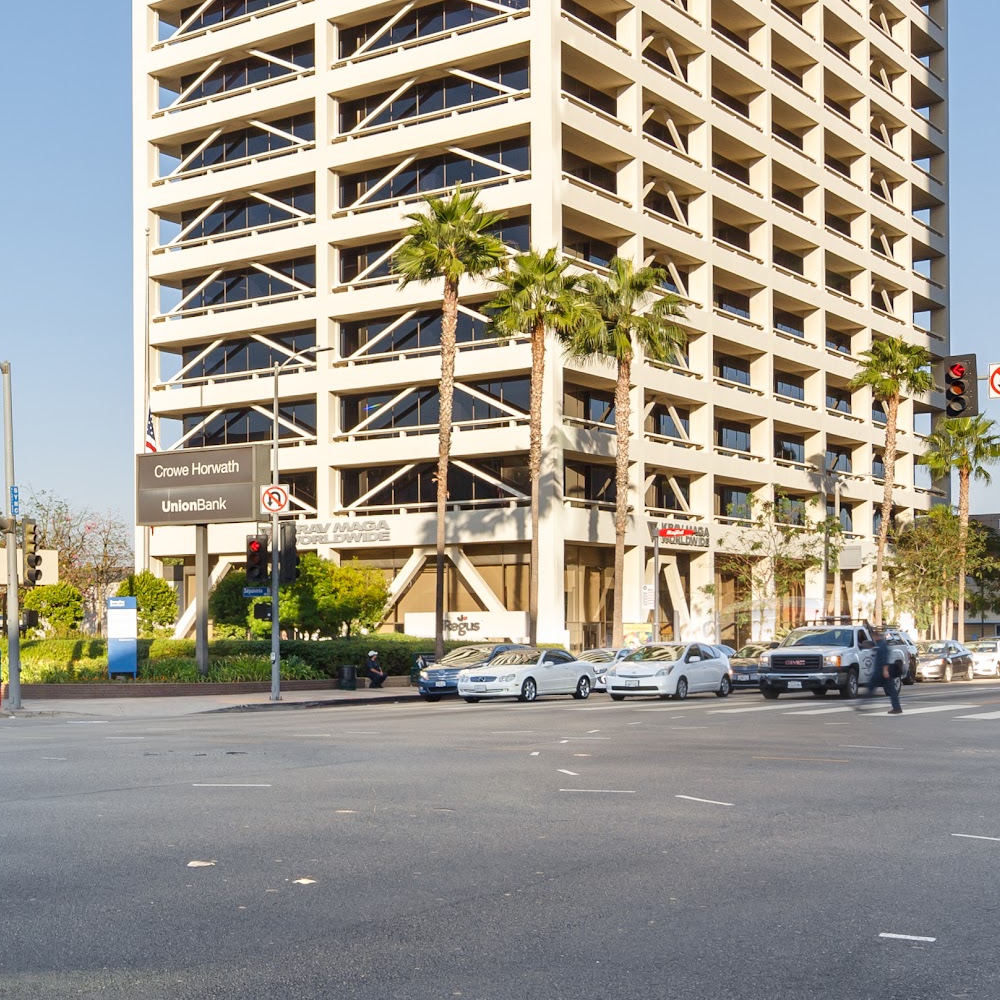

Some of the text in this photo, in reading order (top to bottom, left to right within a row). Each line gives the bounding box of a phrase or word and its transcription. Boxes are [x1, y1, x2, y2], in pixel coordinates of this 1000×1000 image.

[154, 459, 240, 478] Crowe Horwath
[161, 497, 227, 512] UnionBank
[296, 520, 390, 535] RAV MAGA
[296, 532, 390, 546] ORLDWIDE
[443, 619, 480, 636] Regus
